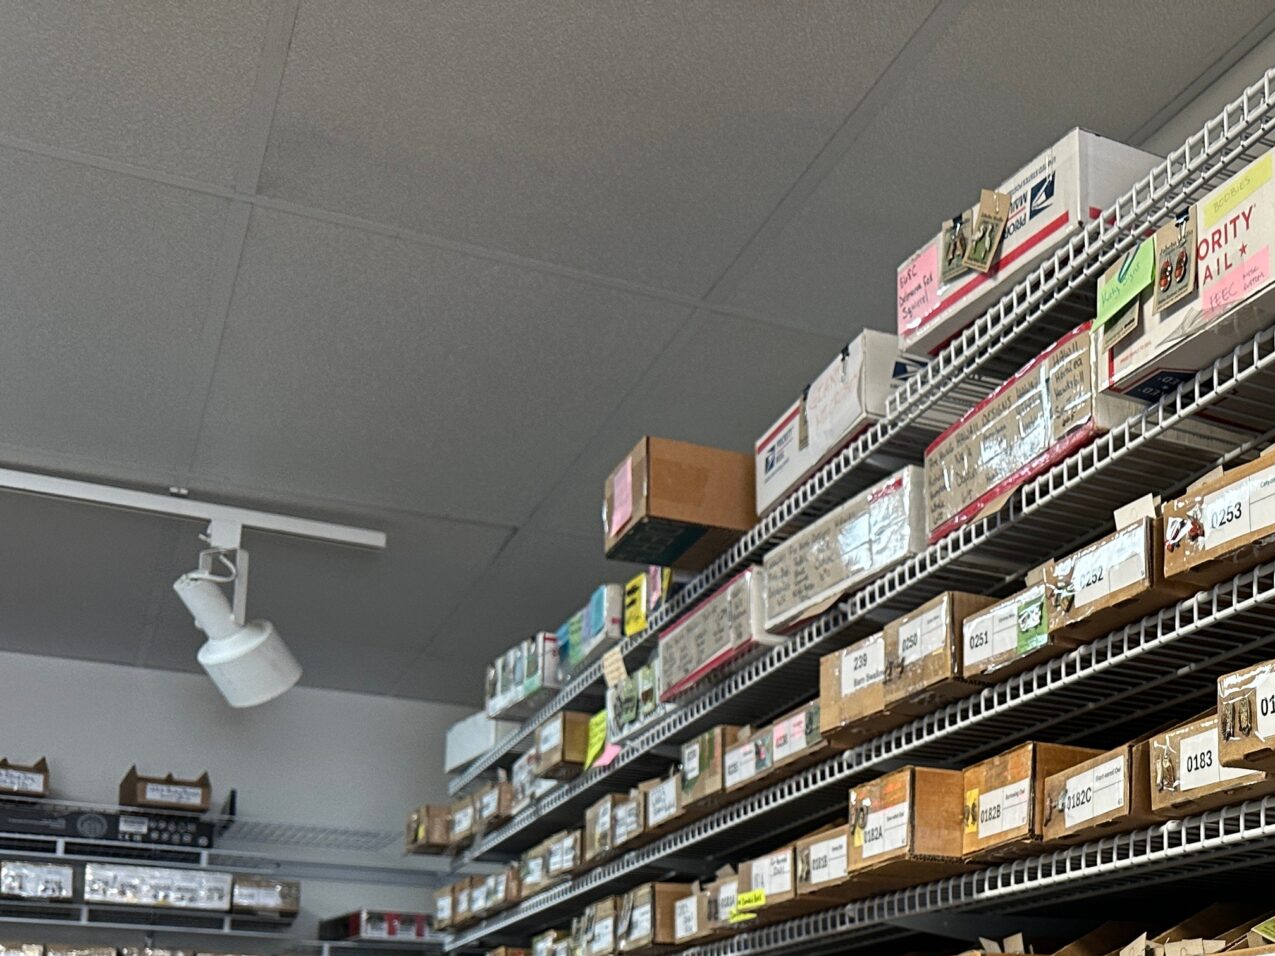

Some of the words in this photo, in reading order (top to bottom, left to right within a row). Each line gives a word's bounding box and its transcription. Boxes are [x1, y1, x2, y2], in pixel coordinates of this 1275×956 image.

[1203, 253, 1233, 286] AIL
[1211, 502, 1242, 529] 0253
[902, 632, 918, 652] 0250
[969, 631, 989, 651] 0251
[1186, 750, 1213, 773] 0183
[1066, 790, 1093, 812] 0182C
[980, 804, 1001, 825] 0182B
